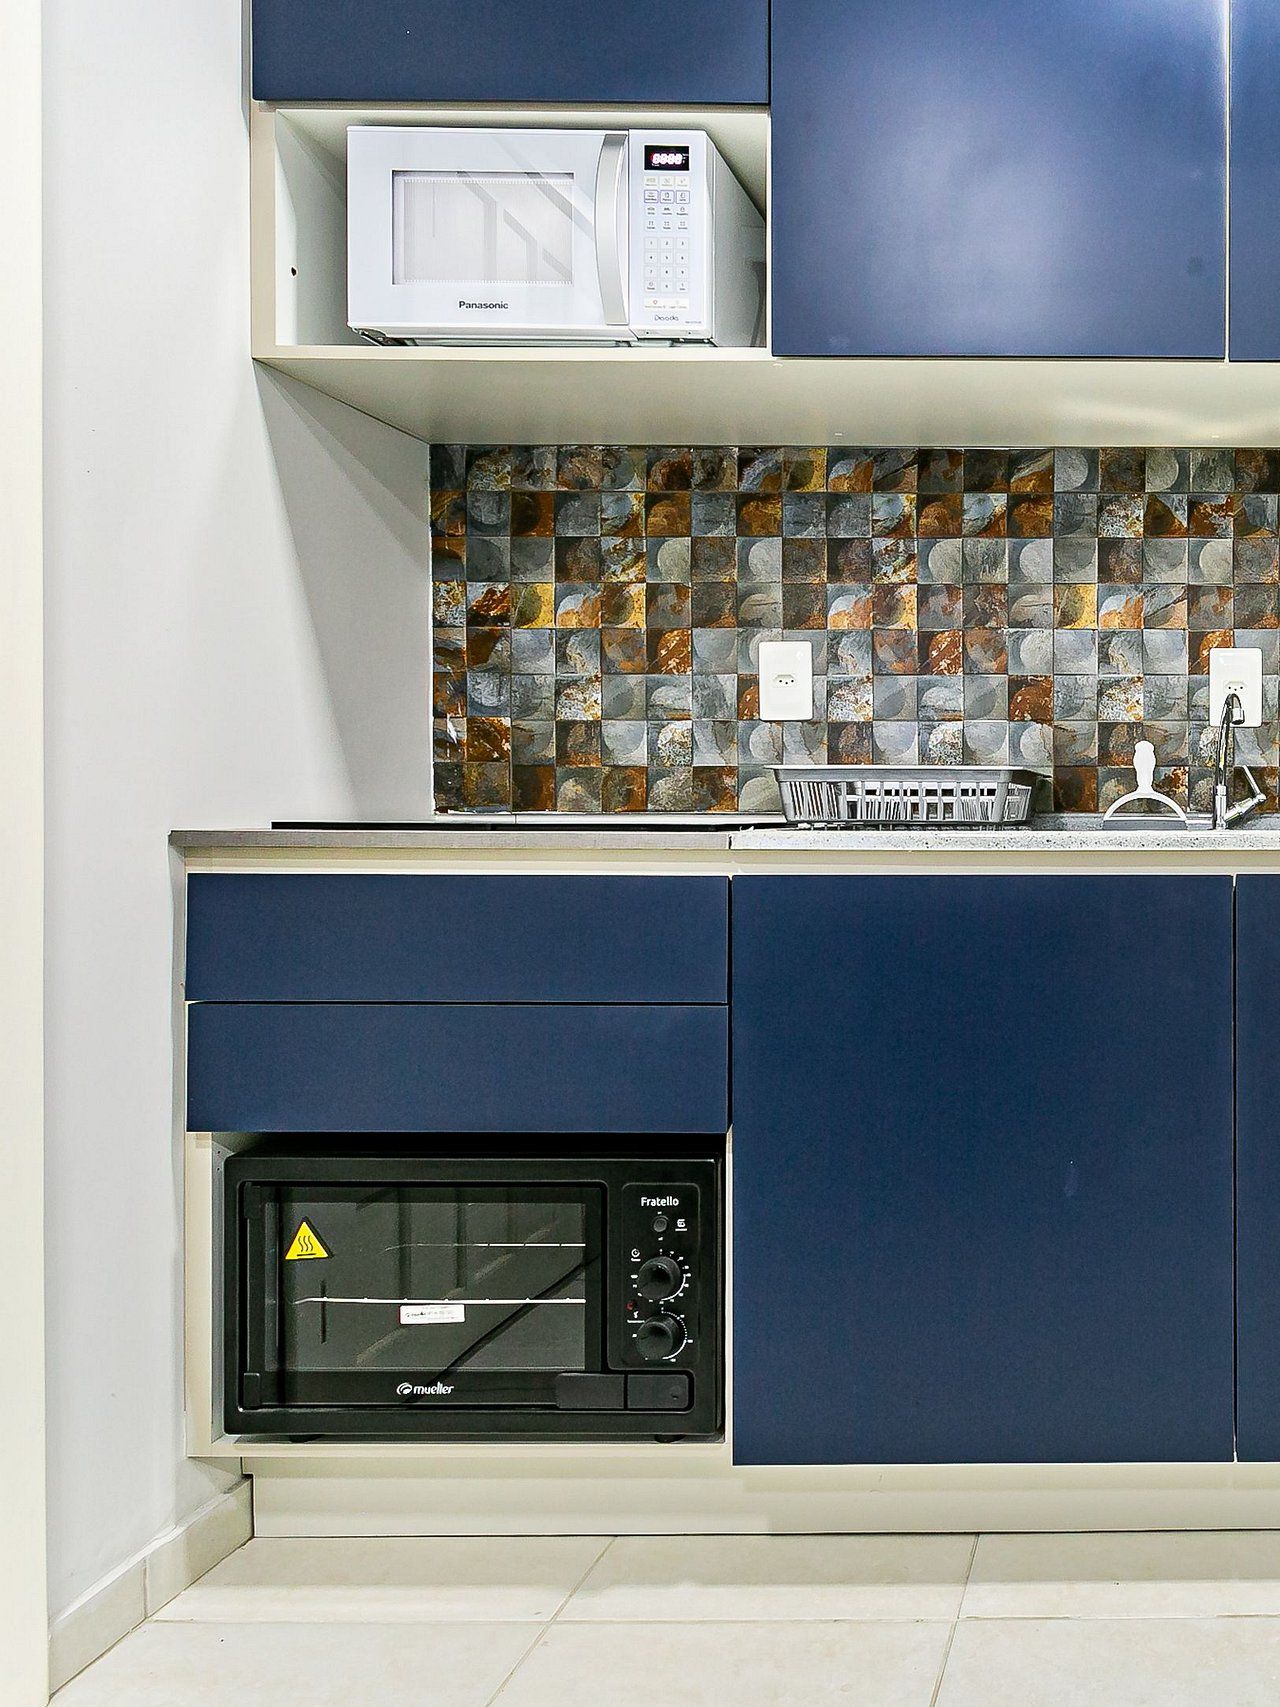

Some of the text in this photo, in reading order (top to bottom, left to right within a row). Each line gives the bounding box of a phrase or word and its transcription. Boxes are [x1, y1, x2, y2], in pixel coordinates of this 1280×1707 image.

[458, 300, 509, 310] Panasonic
[640, 1196, 679, 1207] Fratello
[413, 1381, 455, 1395] mueller
